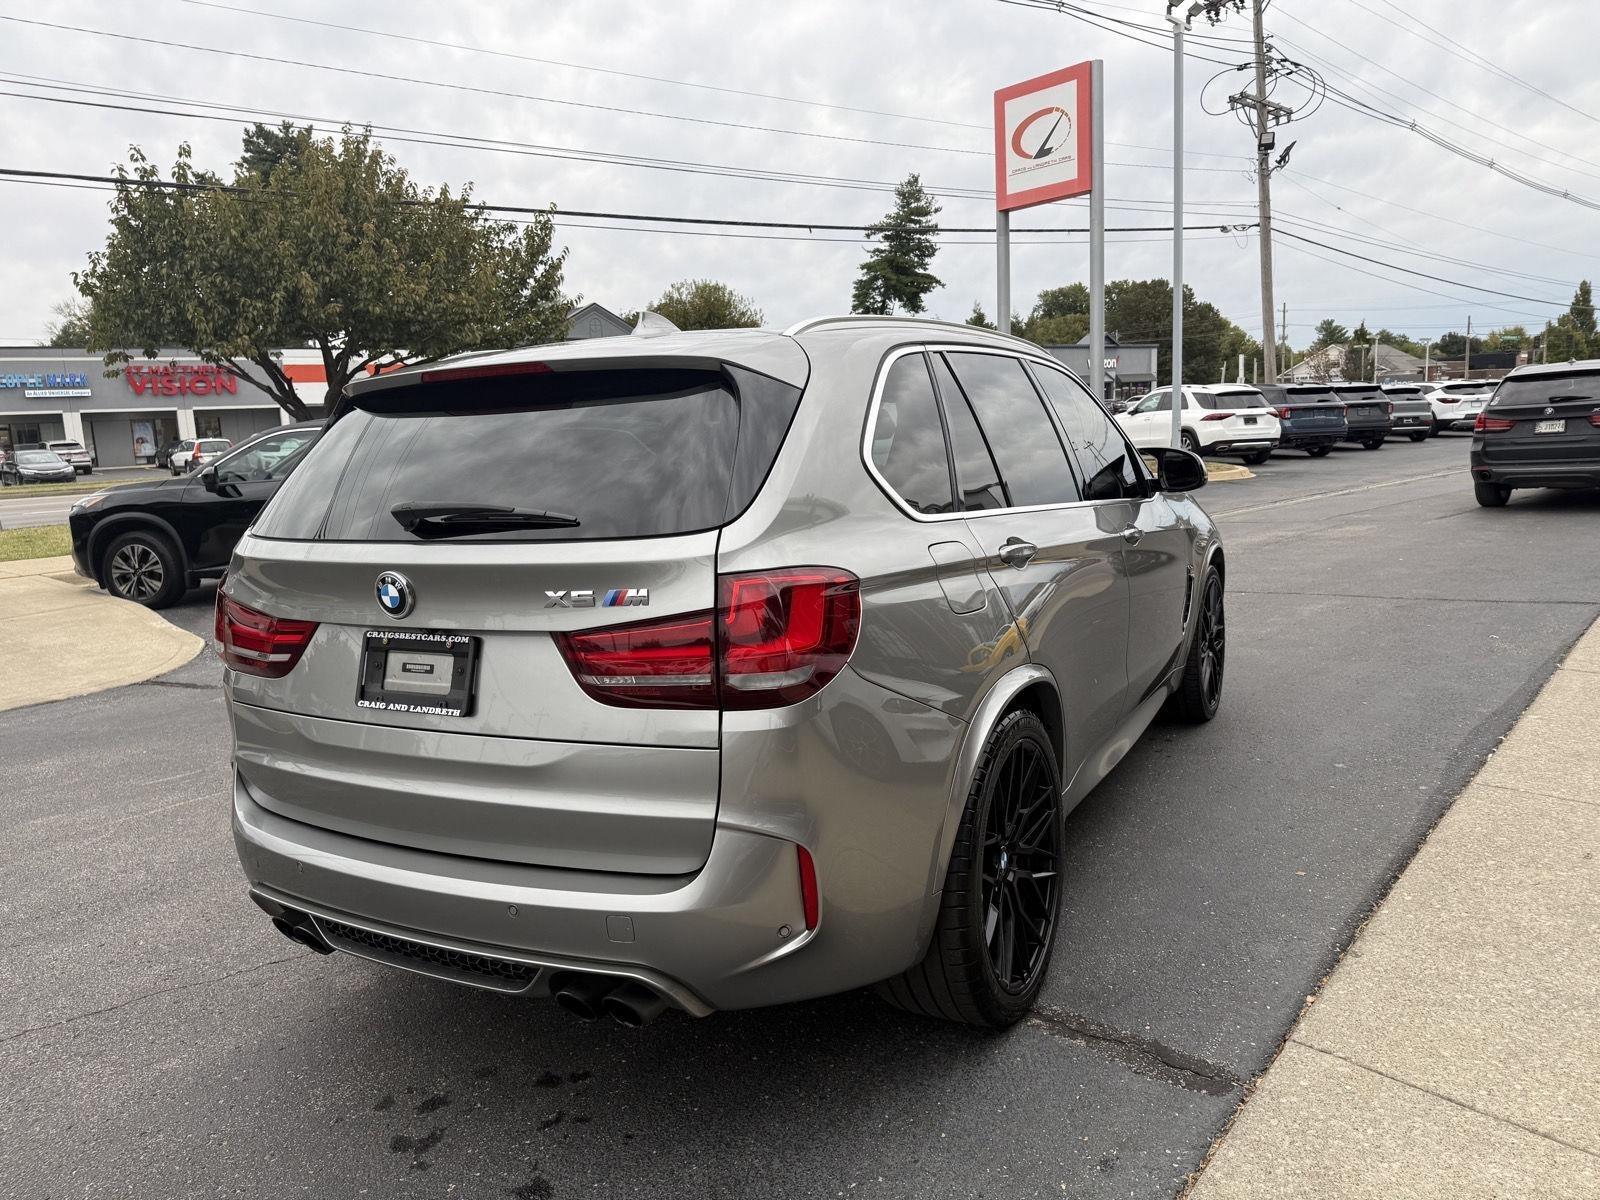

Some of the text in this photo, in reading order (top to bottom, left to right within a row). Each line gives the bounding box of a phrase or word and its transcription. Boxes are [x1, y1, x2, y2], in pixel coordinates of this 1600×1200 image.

[126, 374, 238, 396] VISION
[544, 590, 595, 608] X5
[366, 631, 469, 643] CRAIGSBESTCARS.COM
[357, 700, 461, 717] CRAIG AND LANDRETH
